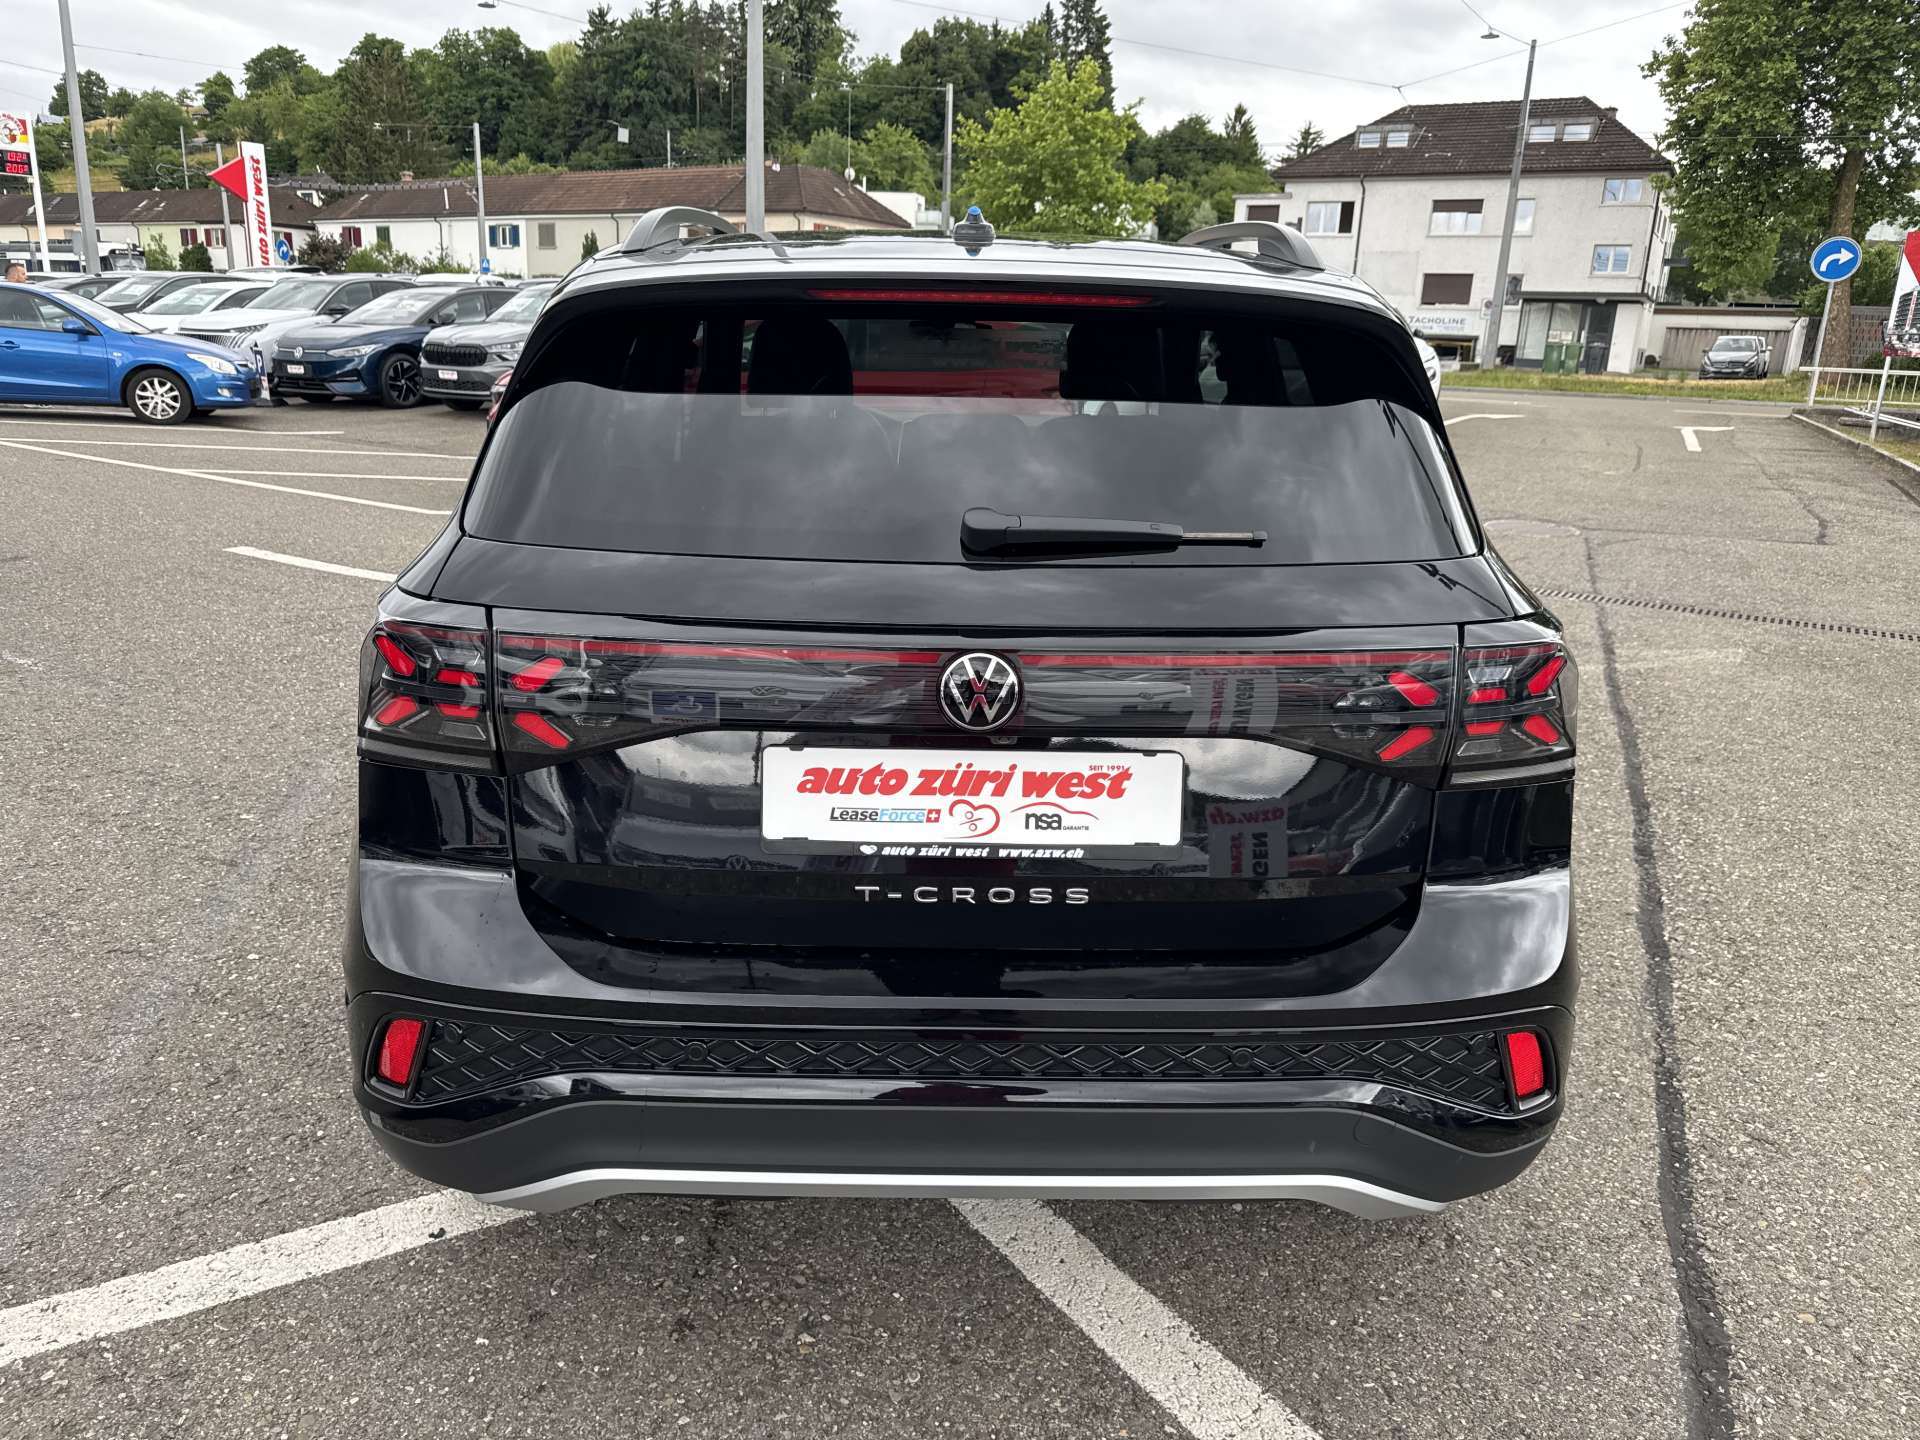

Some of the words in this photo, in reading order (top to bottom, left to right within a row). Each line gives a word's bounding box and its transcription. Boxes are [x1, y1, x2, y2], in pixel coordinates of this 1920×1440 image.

[250, 155, 263, 197] west
[253, 197, 267, 238] züri
[259, 237, 271, 266] uto
[796, 762, 909, 796] auto
[909, 762, 1018, 797] züri
[1021, 766, 1134, 799] west
[829, 807, 926, 823] LeaseForce
[1024, 812, 1062, 830] nsa
[881, 846, 916, 857] auto
[918, 845, 952, 857] züri
[955, 847, 990, 857] west
[998, 848, 1085, 859] www.azw.ch
[854, 885, 1089, 905] T-CROSS
